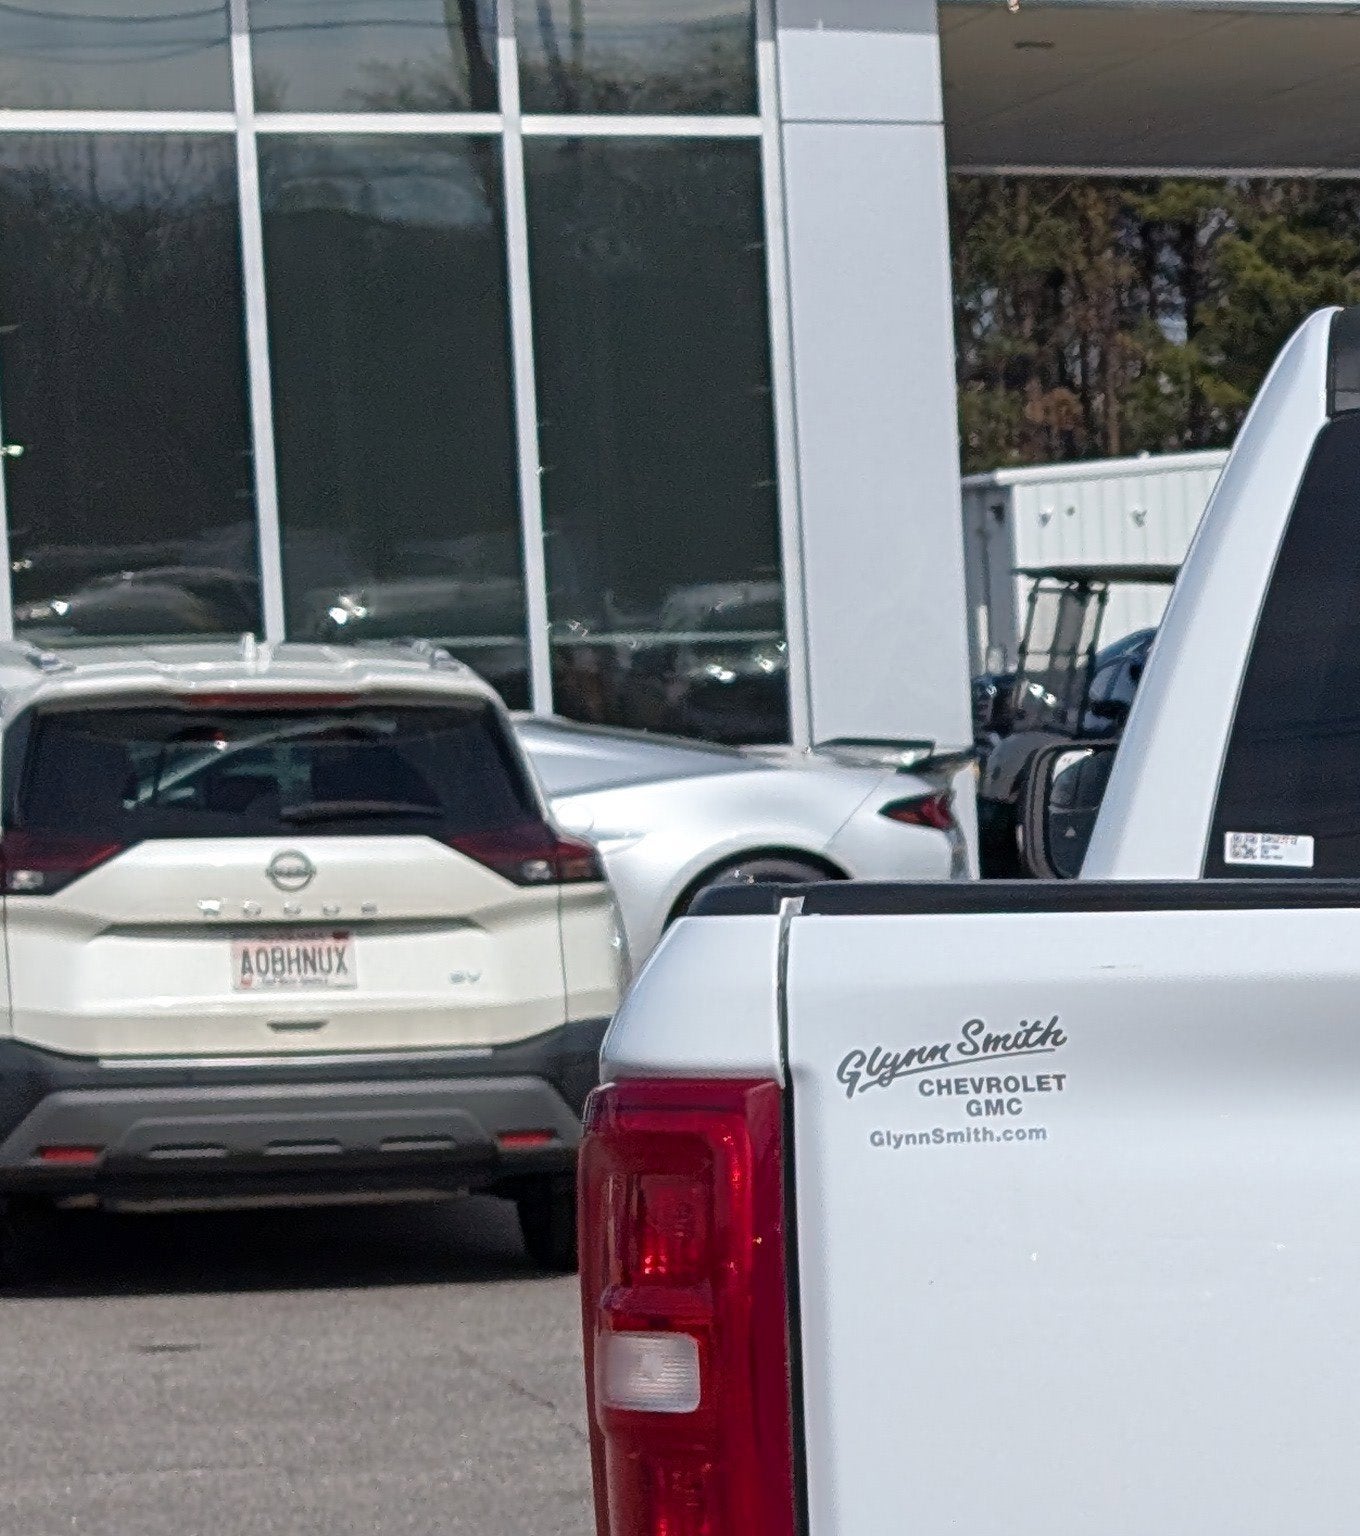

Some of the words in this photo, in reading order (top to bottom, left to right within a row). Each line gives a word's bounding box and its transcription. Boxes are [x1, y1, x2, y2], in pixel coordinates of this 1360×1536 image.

[836, 1045, 952, 1100] Glynn
[956, 1014, 1068, 1057] Smith
[917, 1073, 1067, 1097] CHEVROLET
[965, 1098, 1024, 1118] GMC
[868, 1126, 1048, 1150] GlynnSmith.com
